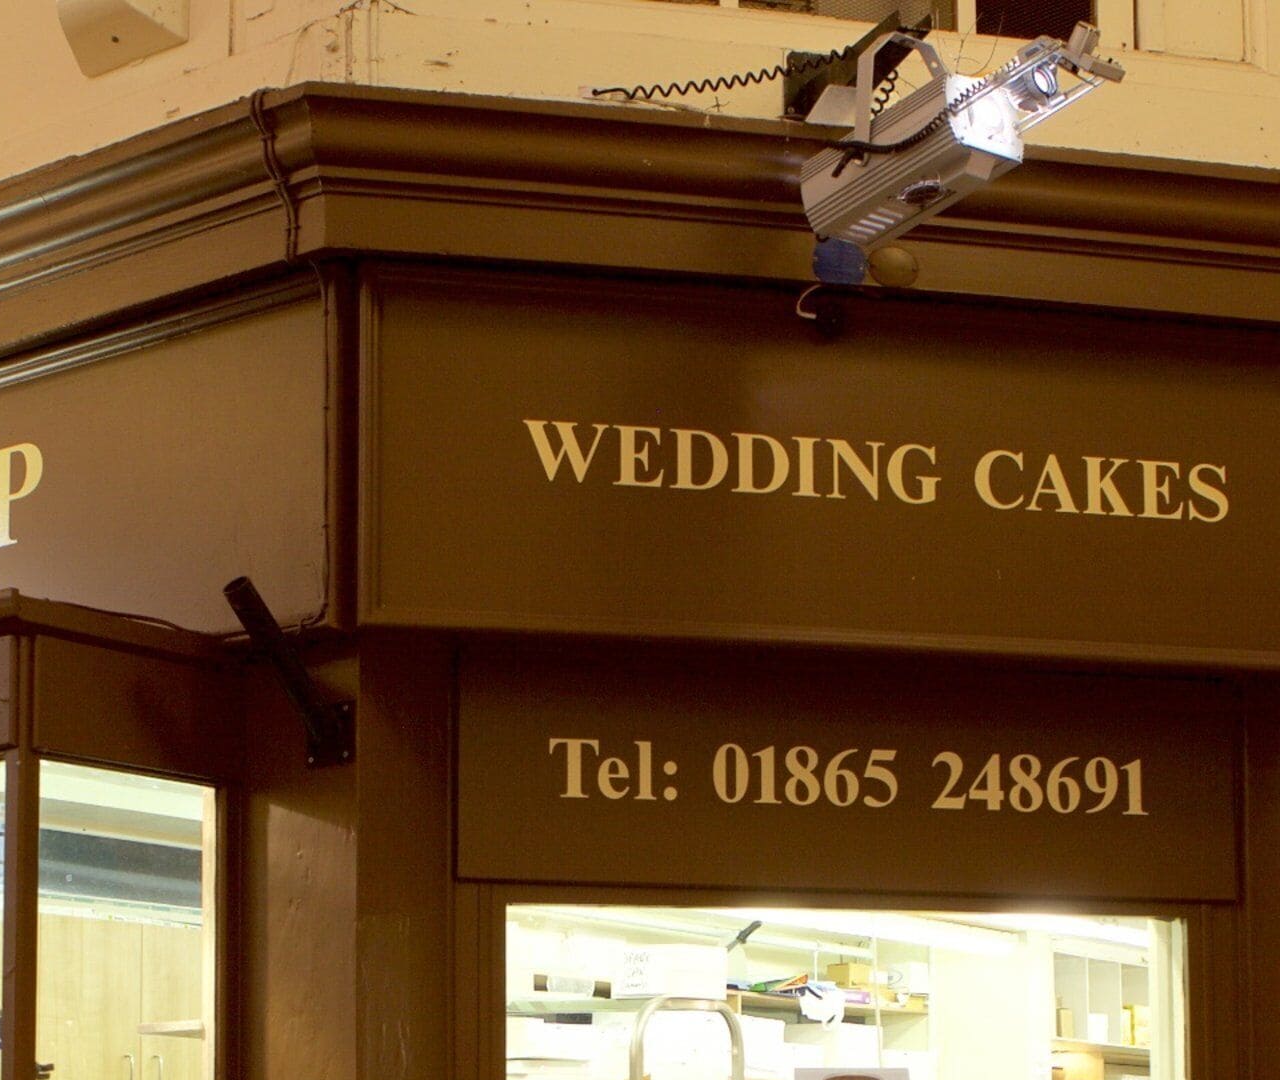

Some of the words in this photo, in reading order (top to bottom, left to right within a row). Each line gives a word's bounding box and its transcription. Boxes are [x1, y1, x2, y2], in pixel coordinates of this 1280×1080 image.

[522, 418, 942, 505] WEDDING
[973, 449, 1230, 523] CAKES
[548, 737, 679, 800] Tel:
[711, 743, 898, 809] 01865
[930, 750, 1149, 816] 248691
